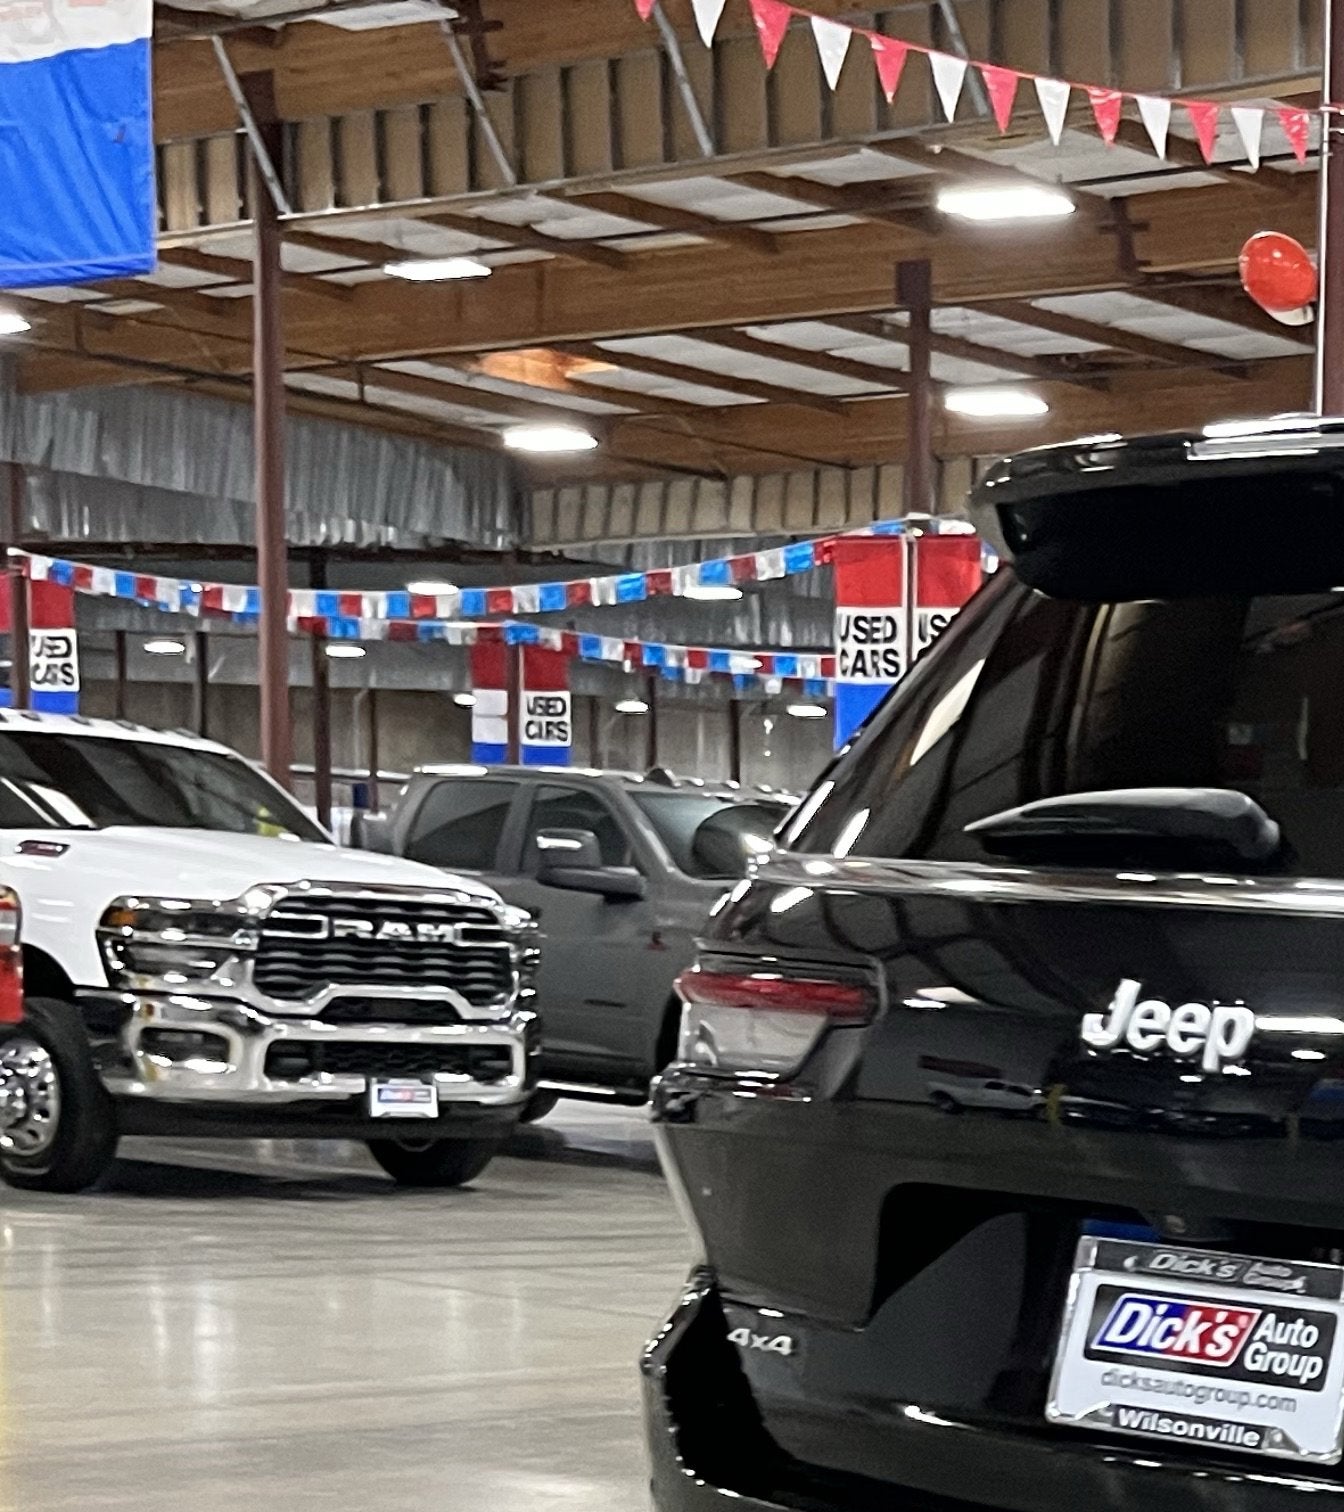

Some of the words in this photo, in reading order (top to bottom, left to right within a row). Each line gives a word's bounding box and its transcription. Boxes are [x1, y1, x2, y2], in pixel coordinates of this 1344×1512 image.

[838, 613, 898, 645] USED
[918, 613, 948, 643] US
[839, 648, 900, 678] CARS
[333, 919, 455, 943] RAM
[1081, 978, 1255, 1072] Jeep
[727, 1327, 792, 1356] 4x4
[1104, 1300, 1241, 1358] Dick's
[1253, 1312, 1319, 1348] Auto
[1243, 1342, 1324, 1384] Group
[1100, 1367, 1298, 1413] dicksautogroup.com
[1117, 1406, 1261, 1447] Wilsonville
